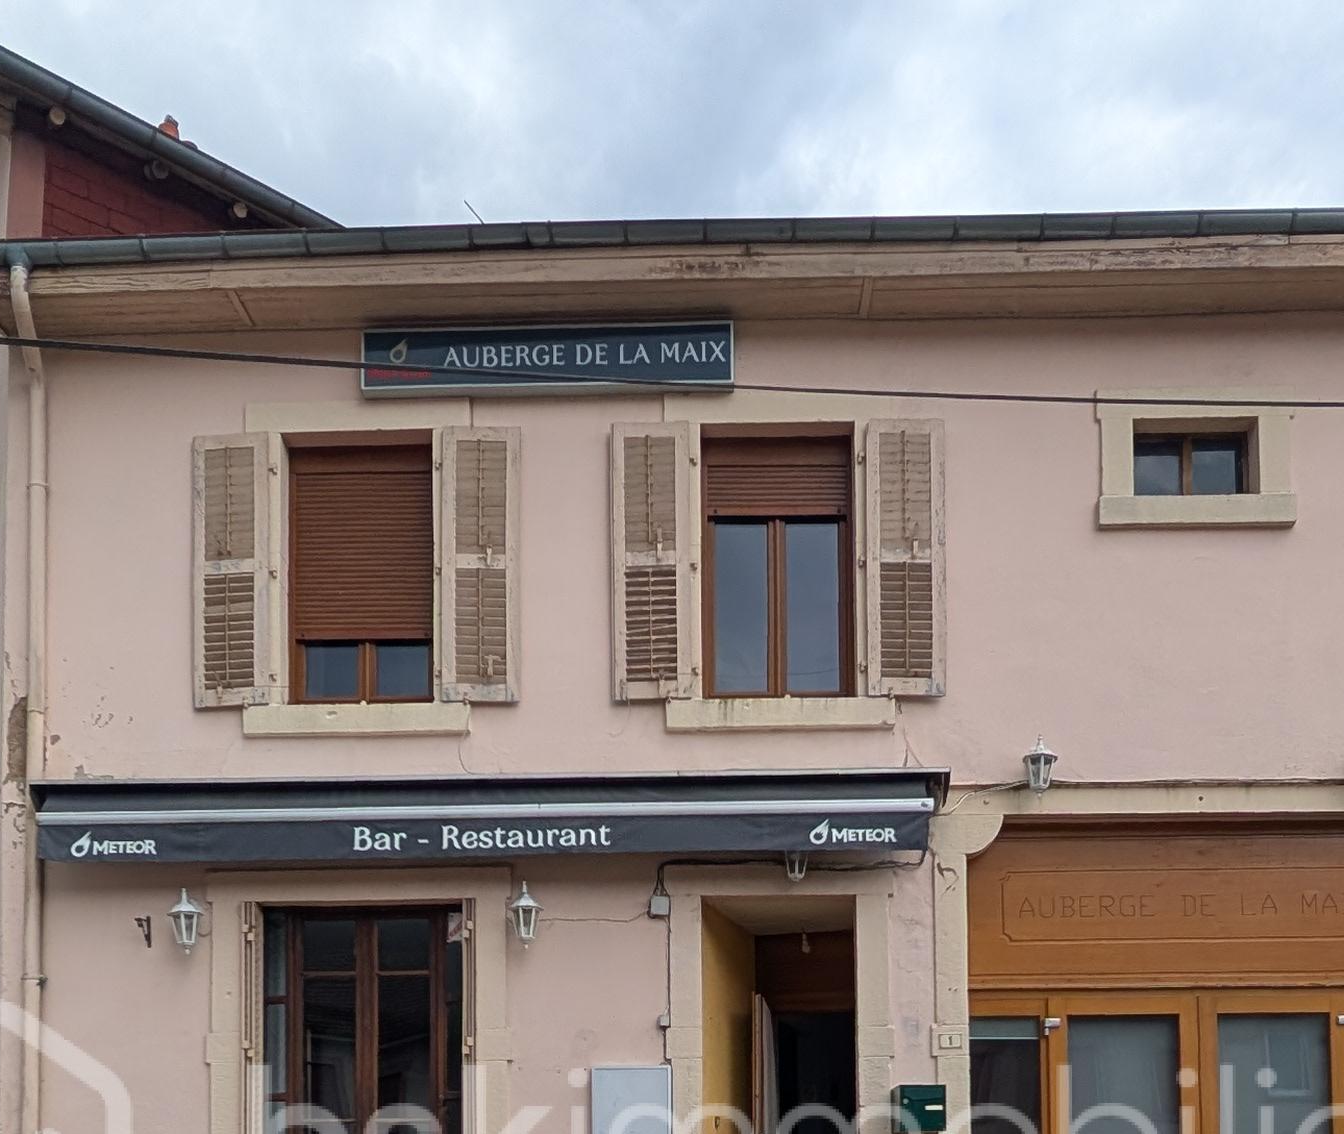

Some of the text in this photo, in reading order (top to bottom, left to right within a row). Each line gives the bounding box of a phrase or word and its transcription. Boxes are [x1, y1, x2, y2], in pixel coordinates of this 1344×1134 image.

[443, 340, 727, 369] AUBERGE DE LA MAIX
[353, 826, 407, 851] Bar
[441, 824, 611, 850] Restaurant
[831, 828, 897, 843] METEOR
[93, 839, 157, 856] METEOR
[1018, 895, 1157, 919] AUBERGE
[1182, 894, 1217, 918] DE
[1239, 893, 1278, 917] LA
[948, 1035, 953, 1046] 1
